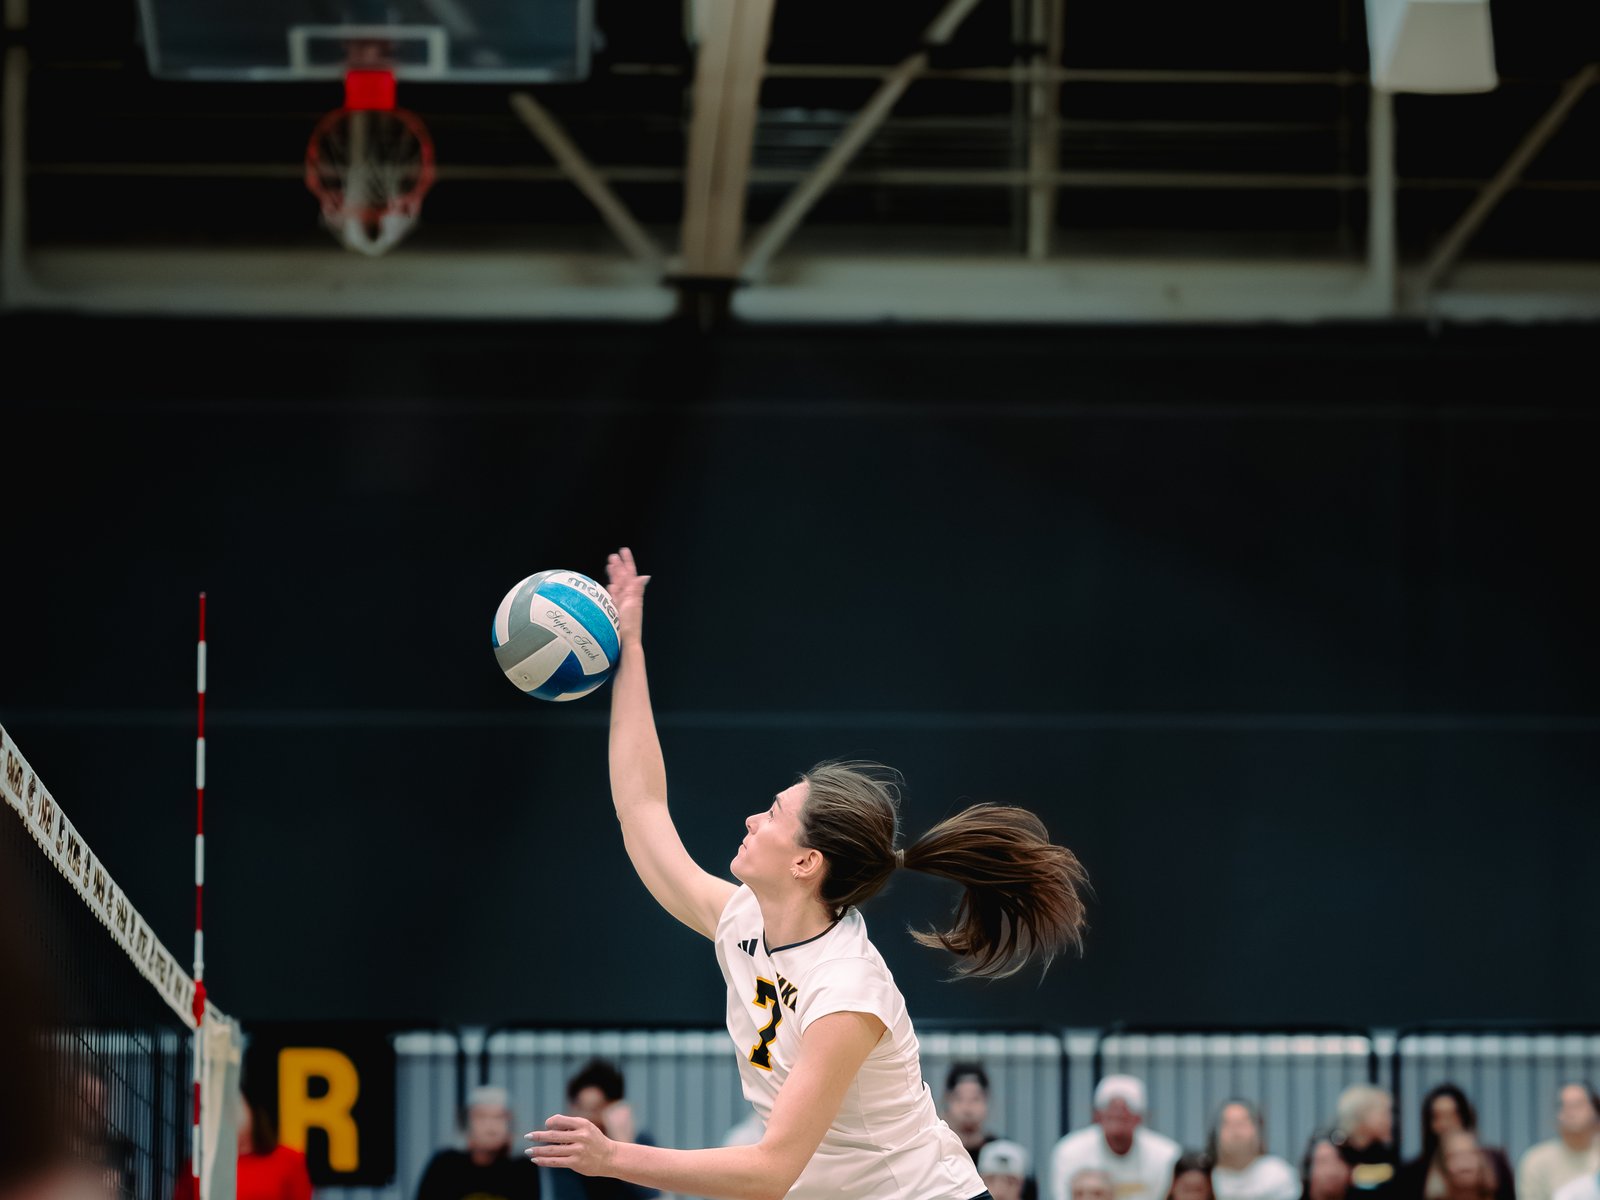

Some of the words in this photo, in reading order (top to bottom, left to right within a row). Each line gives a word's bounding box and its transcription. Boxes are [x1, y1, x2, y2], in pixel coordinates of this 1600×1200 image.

[546, 610, 572, 634] Super
[575, 635, 600, 661] Touch
[567, 577, 620, 632] molten
[750, 975, 783, 1072] 7
[278, 1047, 359, 1172] R
